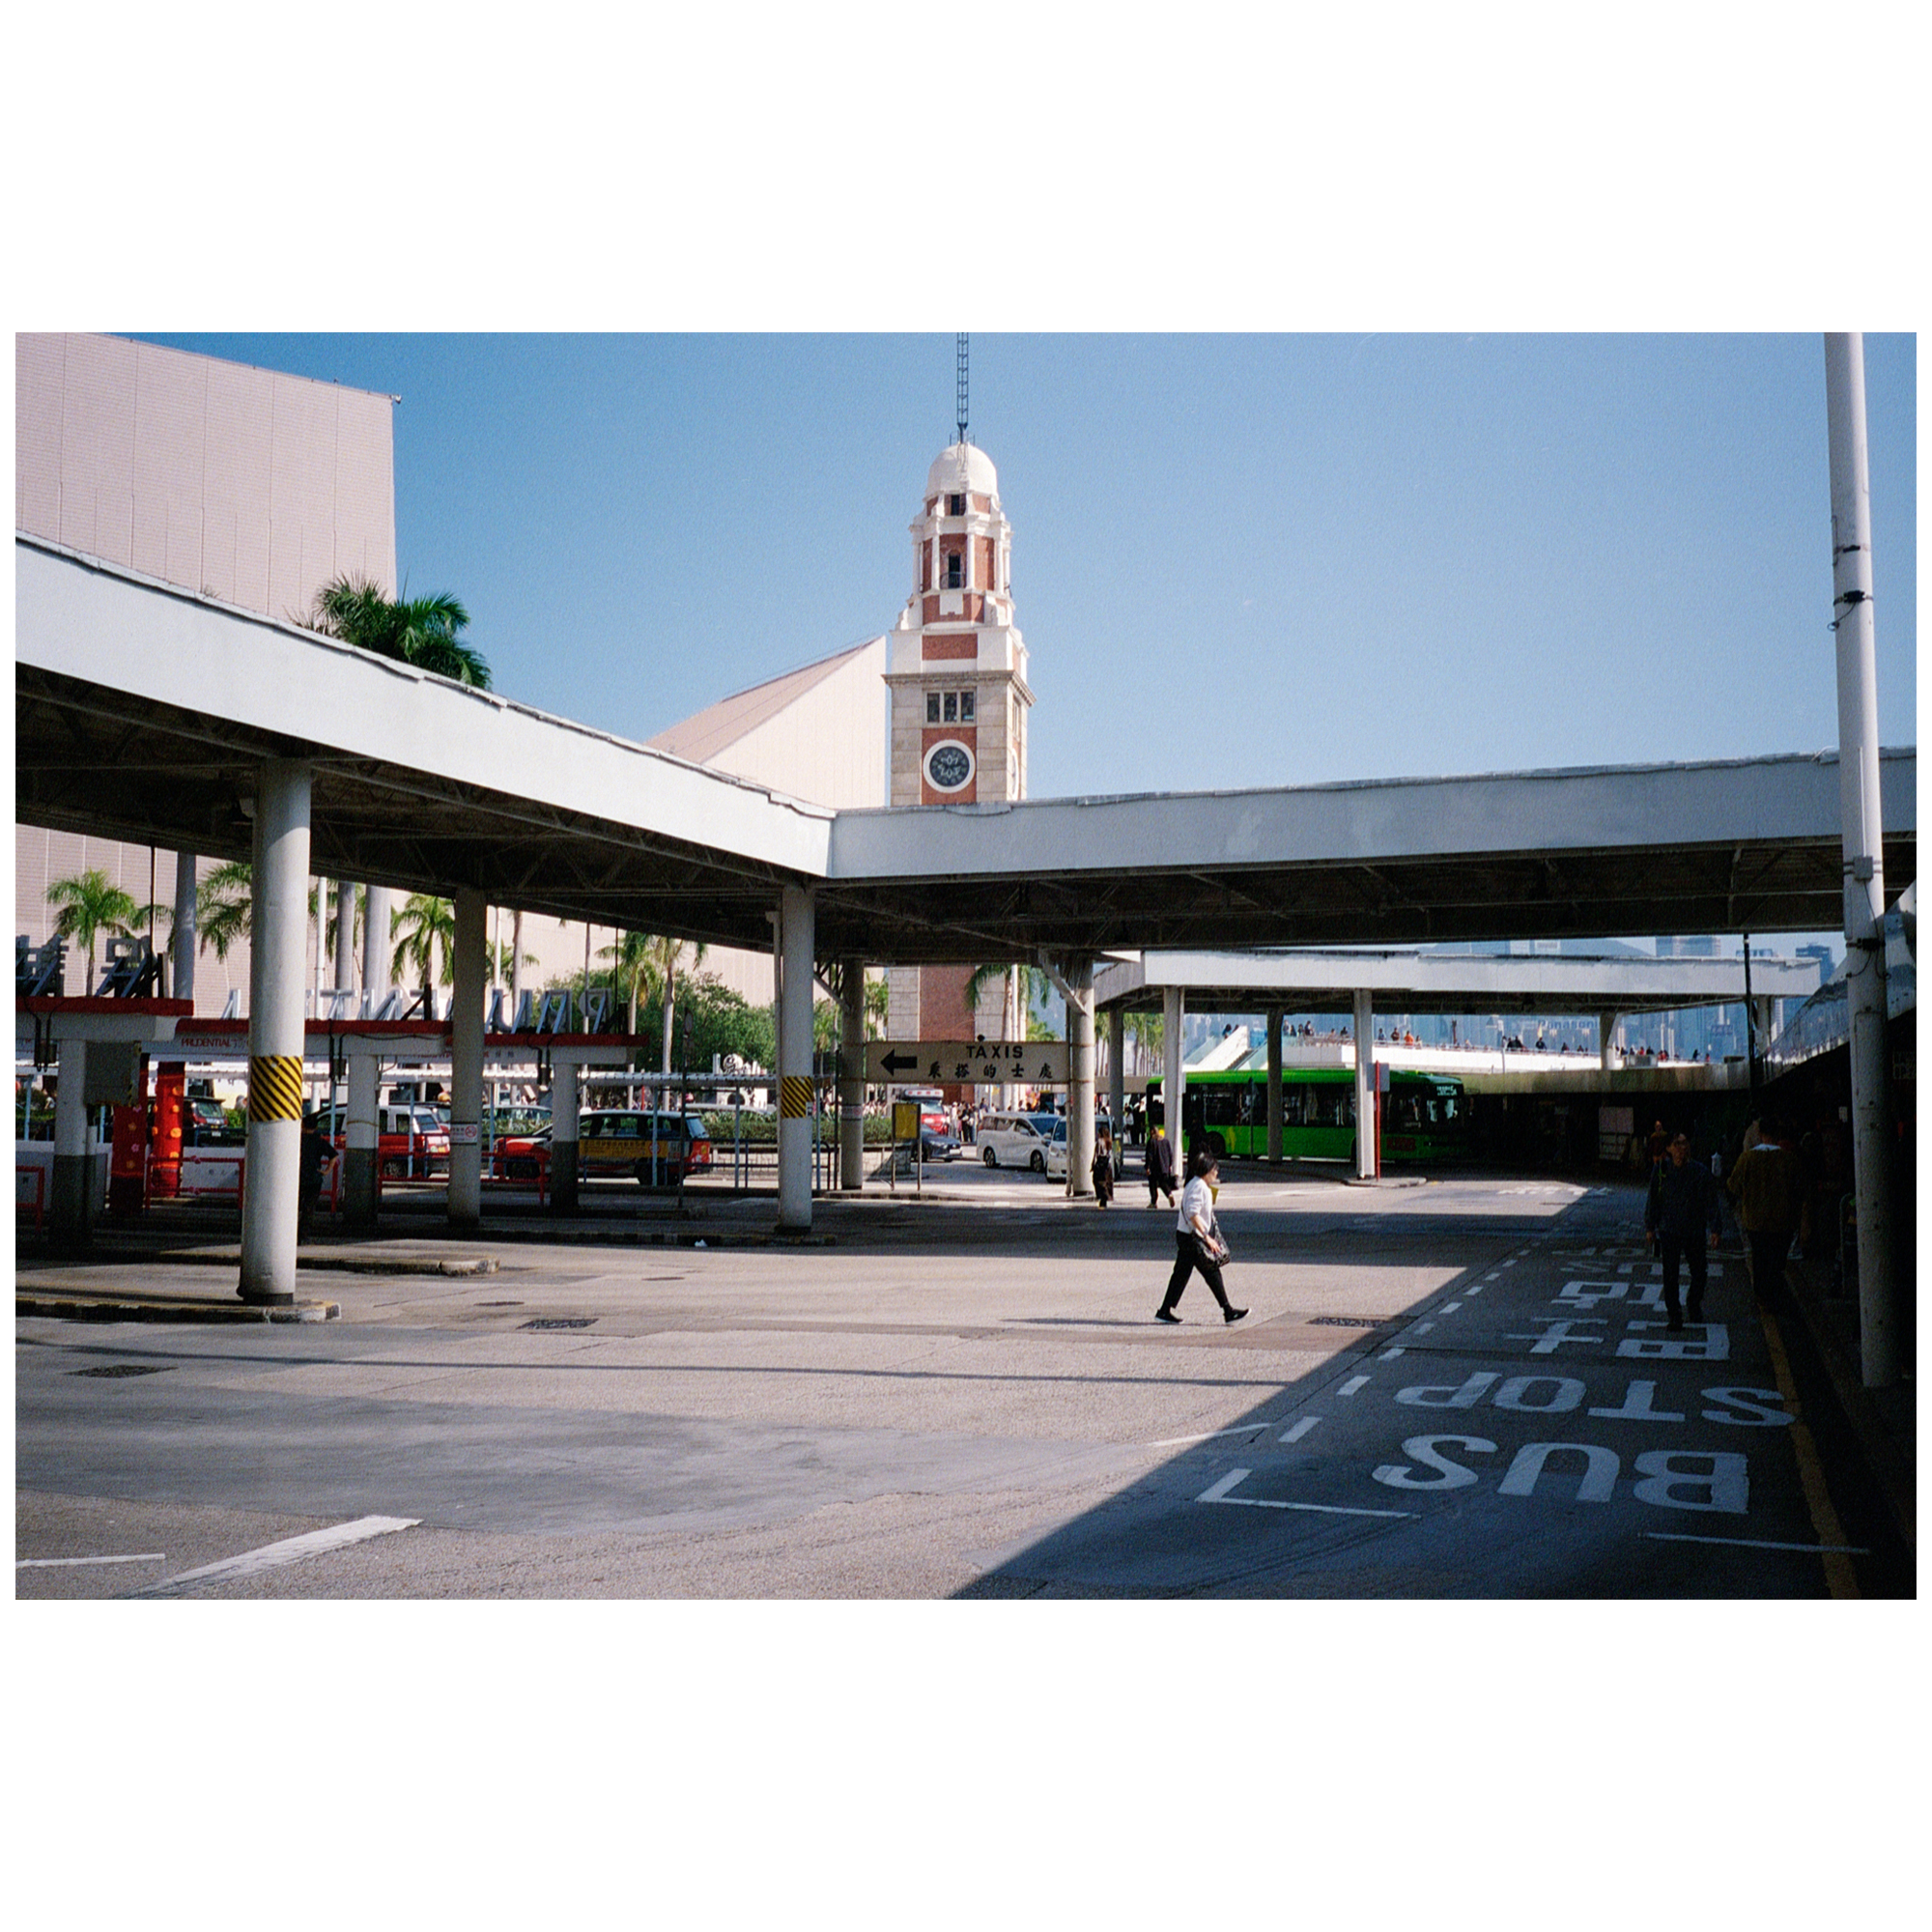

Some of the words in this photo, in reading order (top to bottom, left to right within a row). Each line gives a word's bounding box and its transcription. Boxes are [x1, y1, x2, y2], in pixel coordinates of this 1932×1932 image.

[1538, 1019, 1599, 1030] Panasoni
[181, 1037, 231, 1047] PRUDENTIAL
[966, 1045, 1023, 1059] TAXIS
[1393, 1372, 1796, 1427] STOP
[1372, 1435, 1750, 1514] BUS
